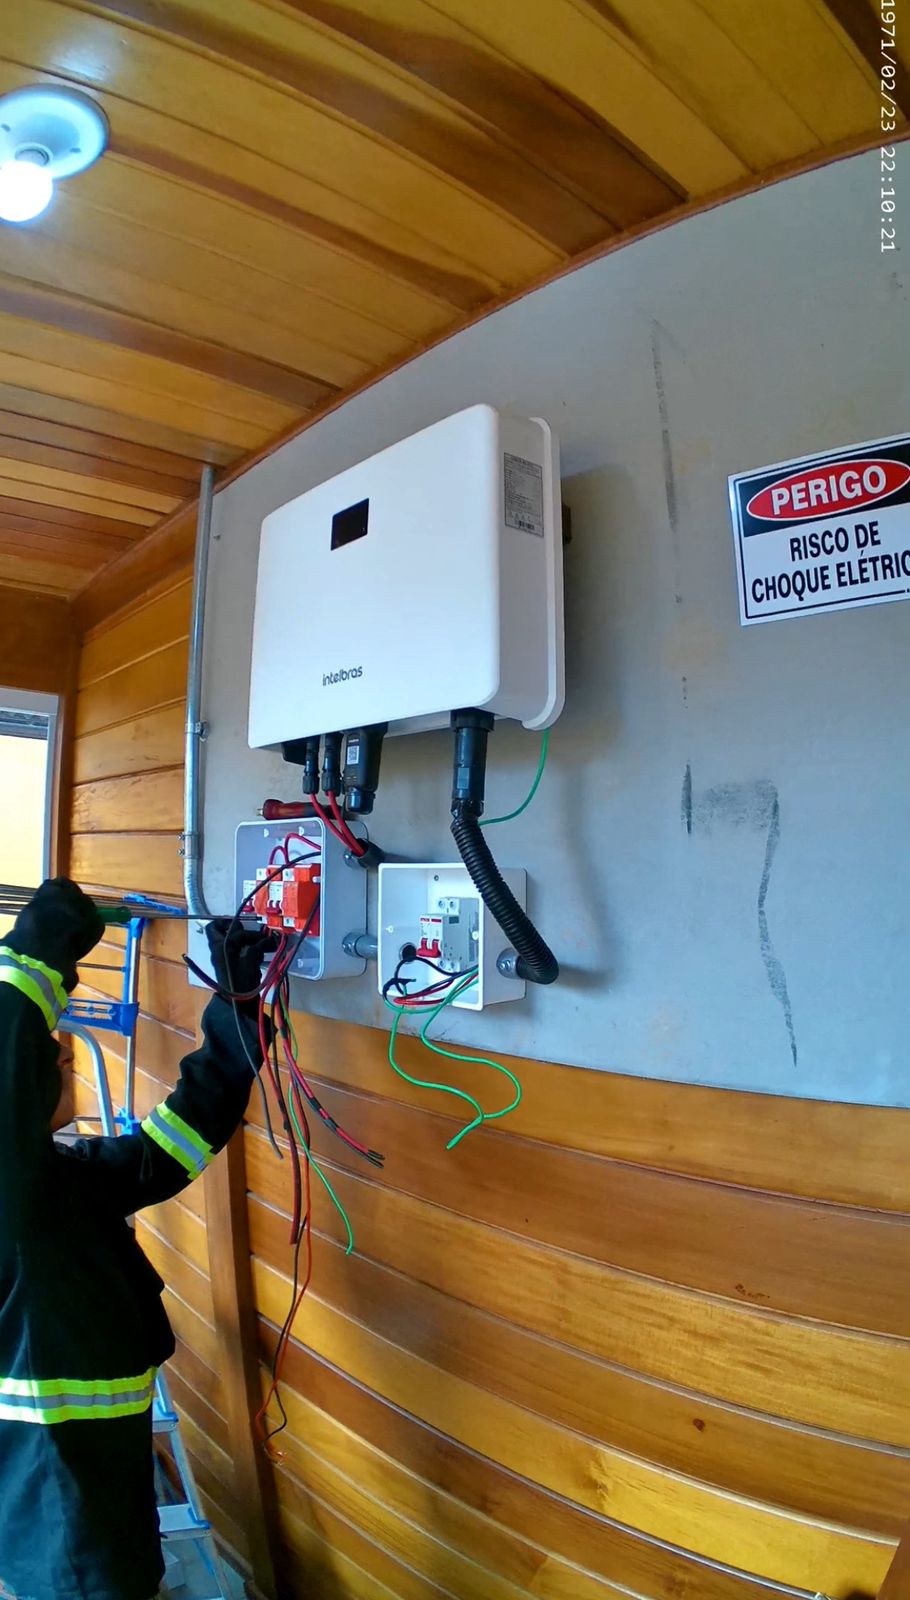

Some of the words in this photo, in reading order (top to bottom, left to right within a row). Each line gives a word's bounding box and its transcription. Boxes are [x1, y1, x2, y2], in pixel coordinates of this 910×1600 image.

[771, 465, 887, 516] PERIGO
[789, 527, 849, 562] RISCO
[854, 520, 881, 549] DE
[752, 565, 831, 603] CHOQUE
[322, 666, 363, 686] intelbras
